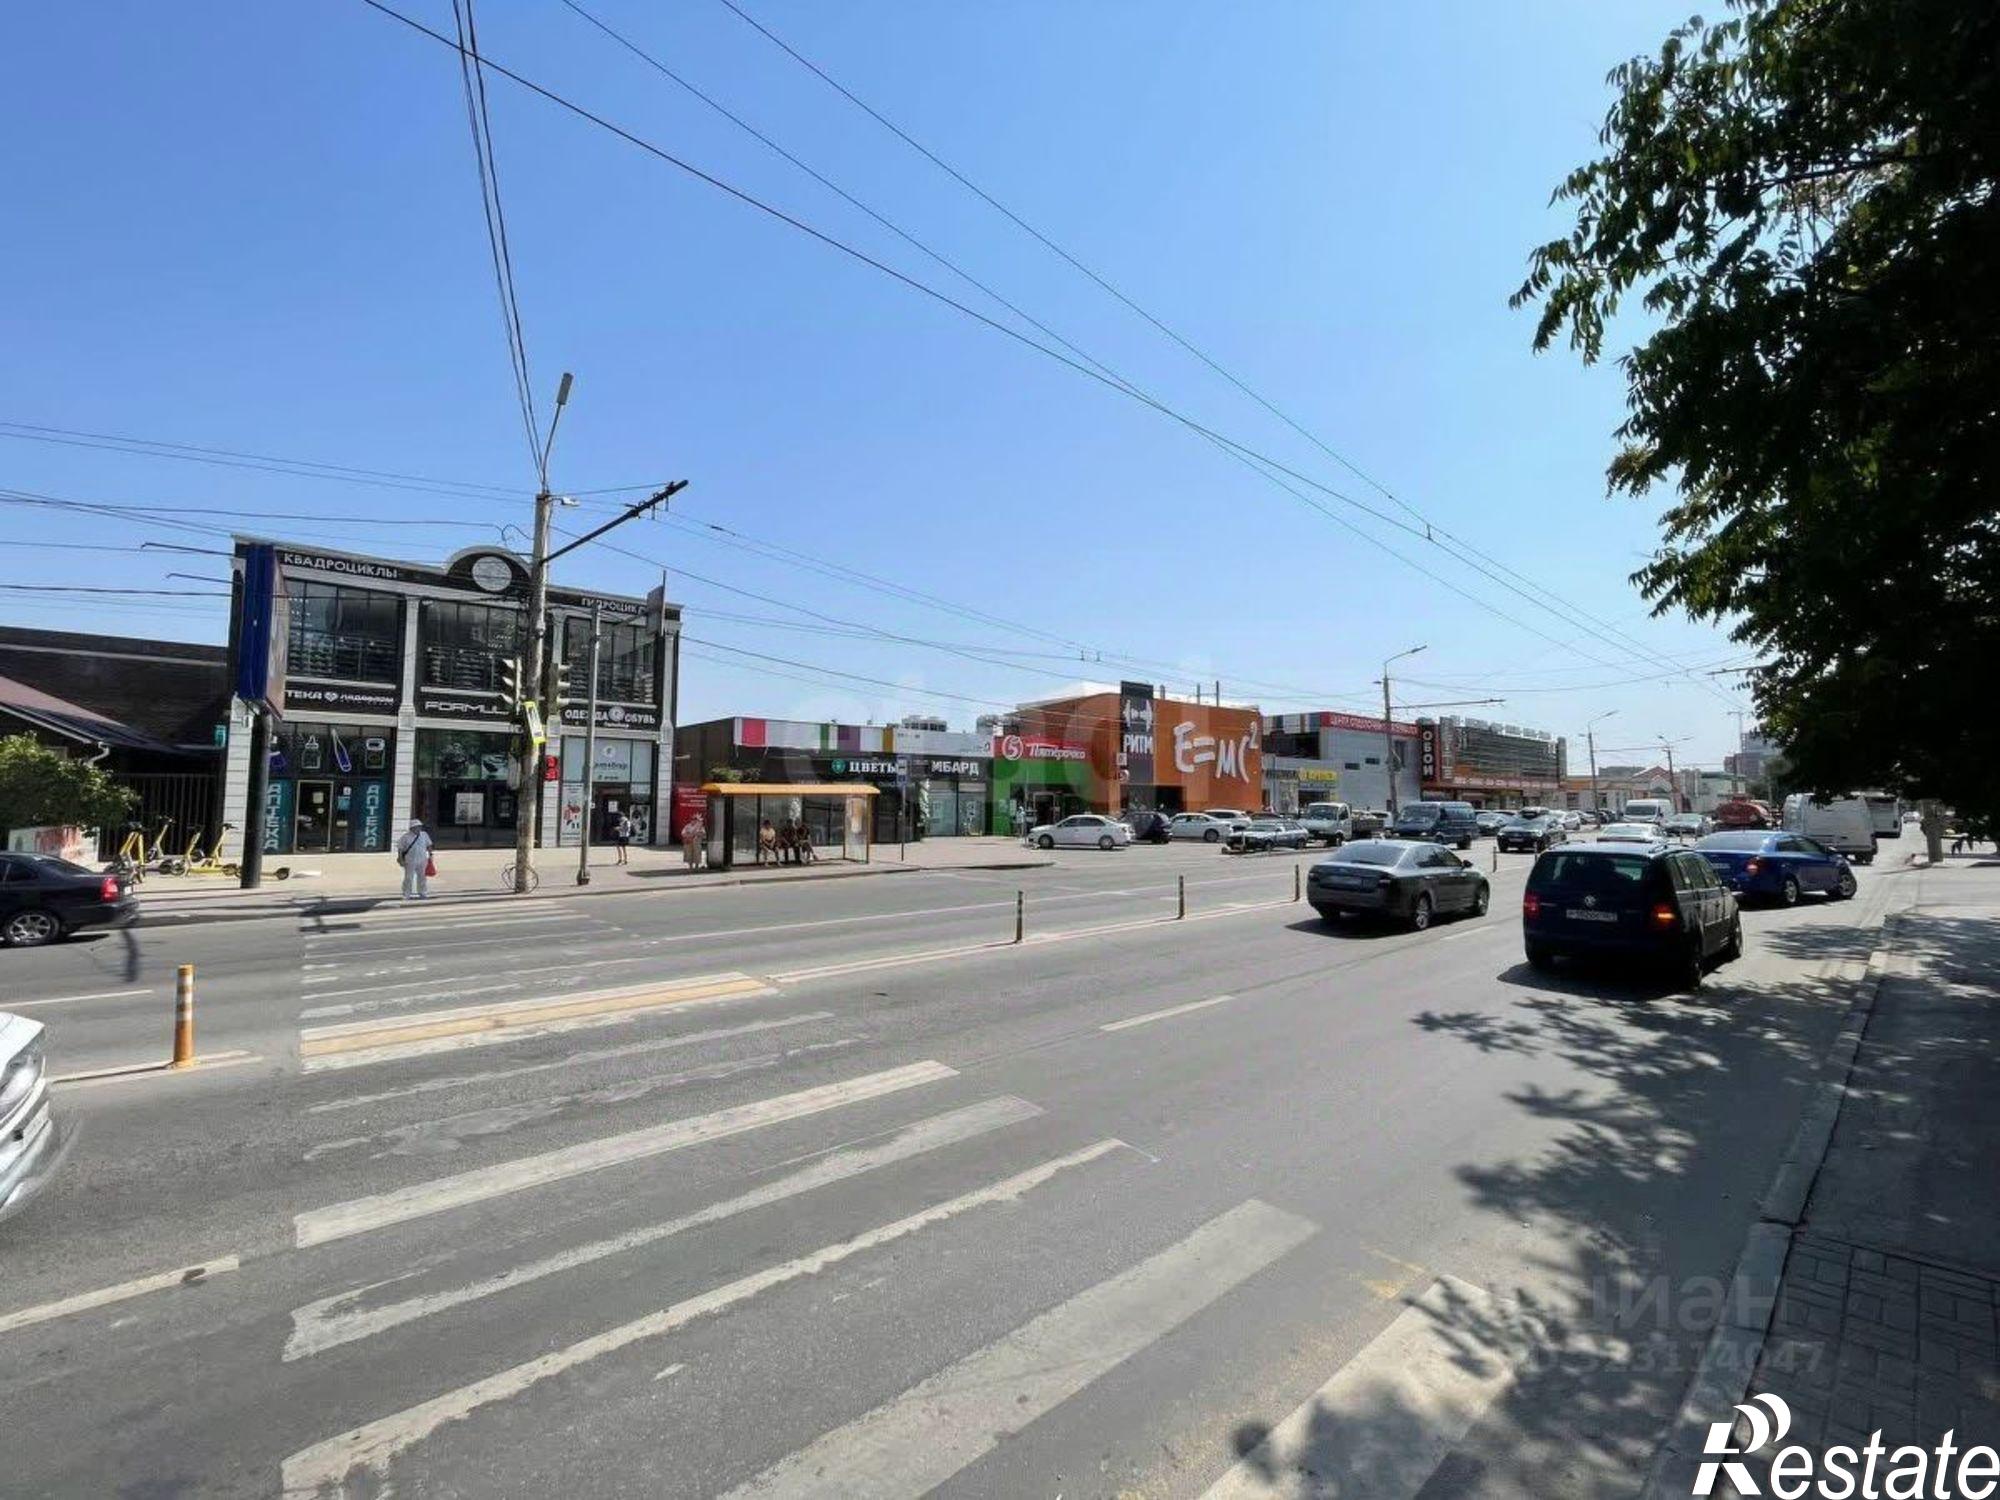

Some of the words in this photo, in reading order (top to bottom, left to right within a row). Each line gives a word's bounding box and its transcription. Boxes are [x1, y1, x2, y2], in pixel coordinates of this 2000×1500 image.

[283, 553, 398, 579] КВАДРОЦИКЛЫ
[284, 690, 322, 700] ТЕКА
[424, 700, 510, 716] FORMUL
[564, 708, 609, 721] ОДЕДА
[624, 713, 656, 725] ОБУВЬ
[1123, 733, 1152, 754] РИТМ
[1422, 730, 1434, 776] ОБОИ
[264, 783, 281, 851] АПТЕКА
[364, 784, 380, 848] АПТЕКА
